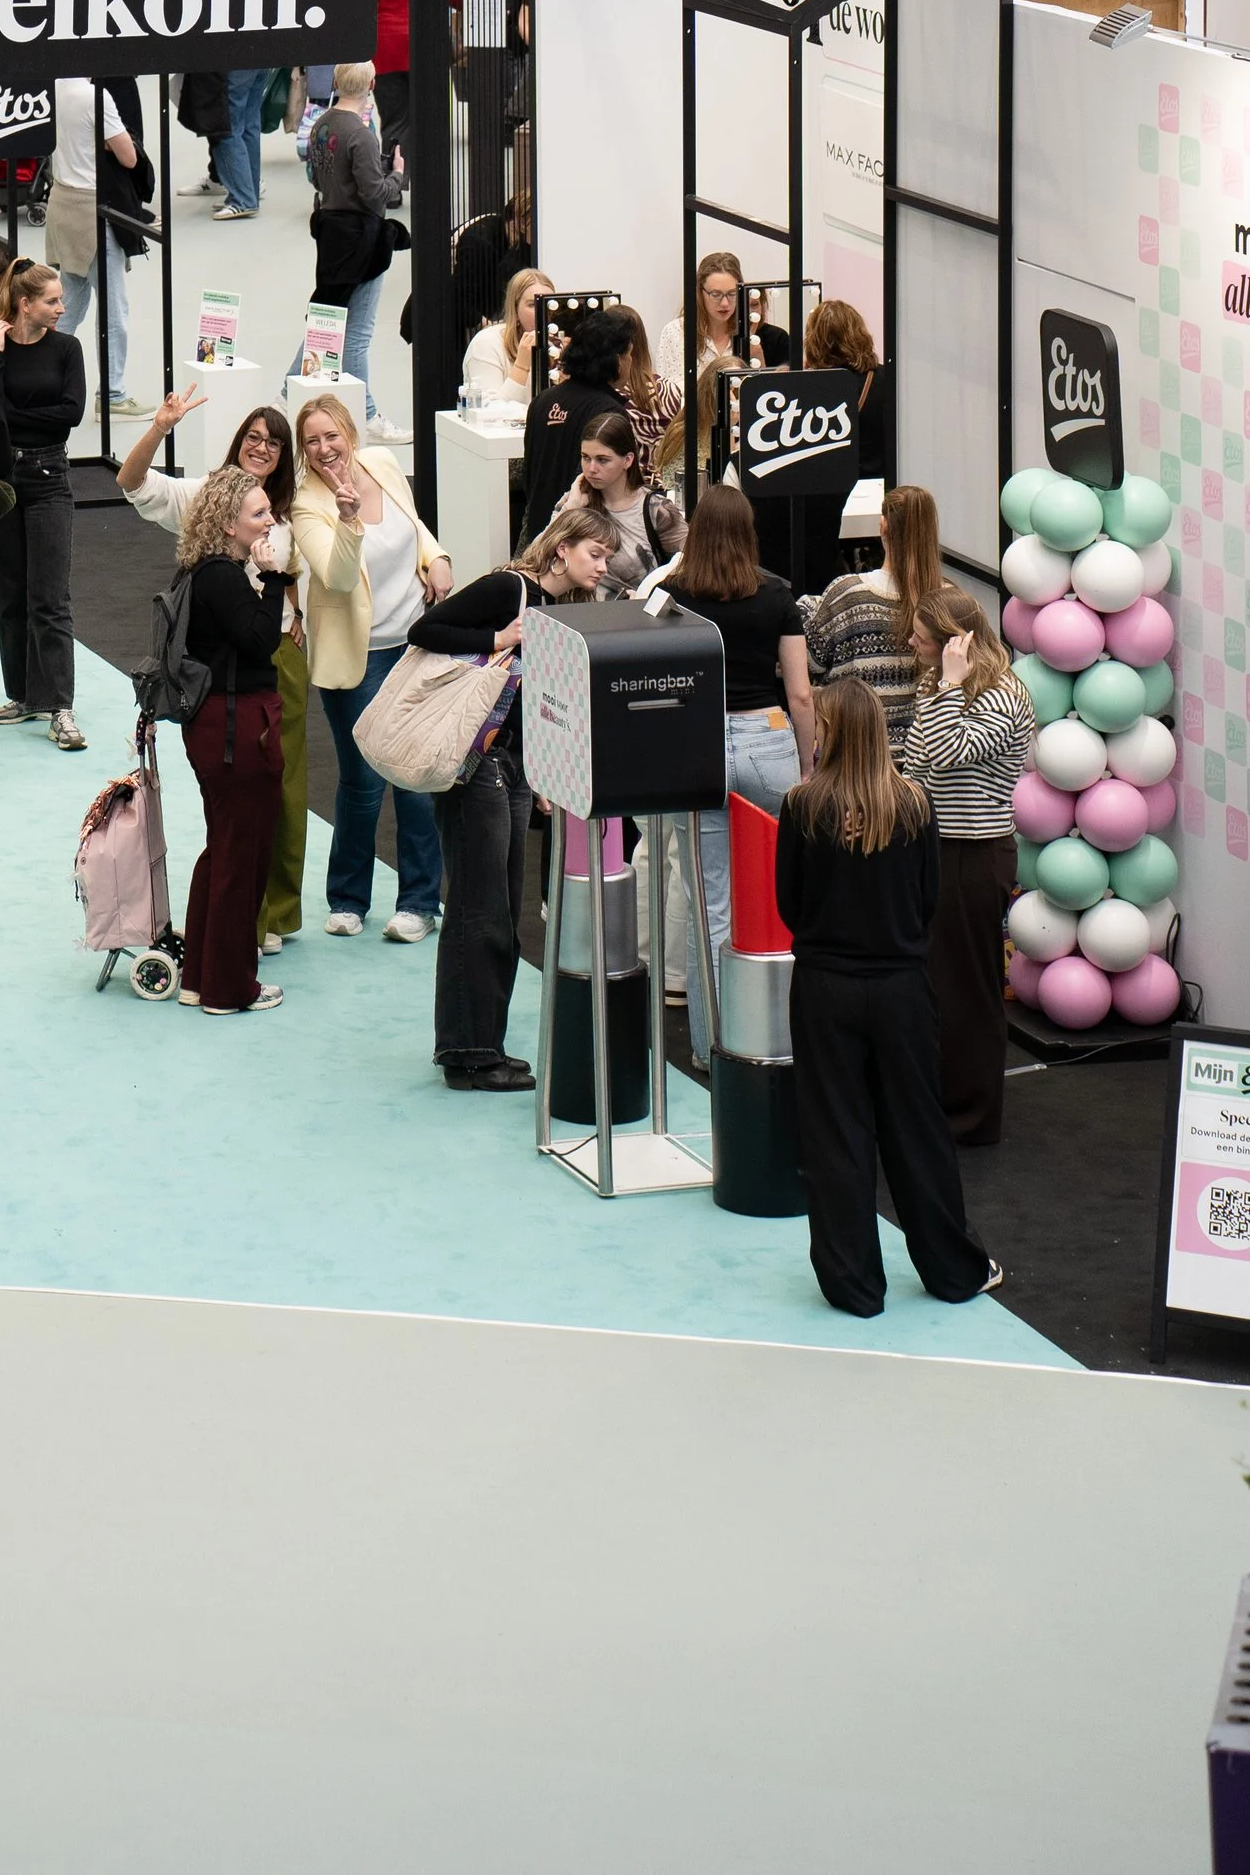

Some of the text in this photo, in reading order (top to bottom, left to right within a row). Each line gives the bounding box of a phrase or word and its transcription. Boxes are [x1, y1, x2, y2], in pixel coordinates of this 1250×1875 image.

[826, 140, 884, 178] MAX FAC
[1048, 336, 1105, 416] Etos
[748, 391, 851, 452] Etos
[1195, 1062, 1234, 1084] Mijn
[1191, 1127, 1237, 1141] Download
